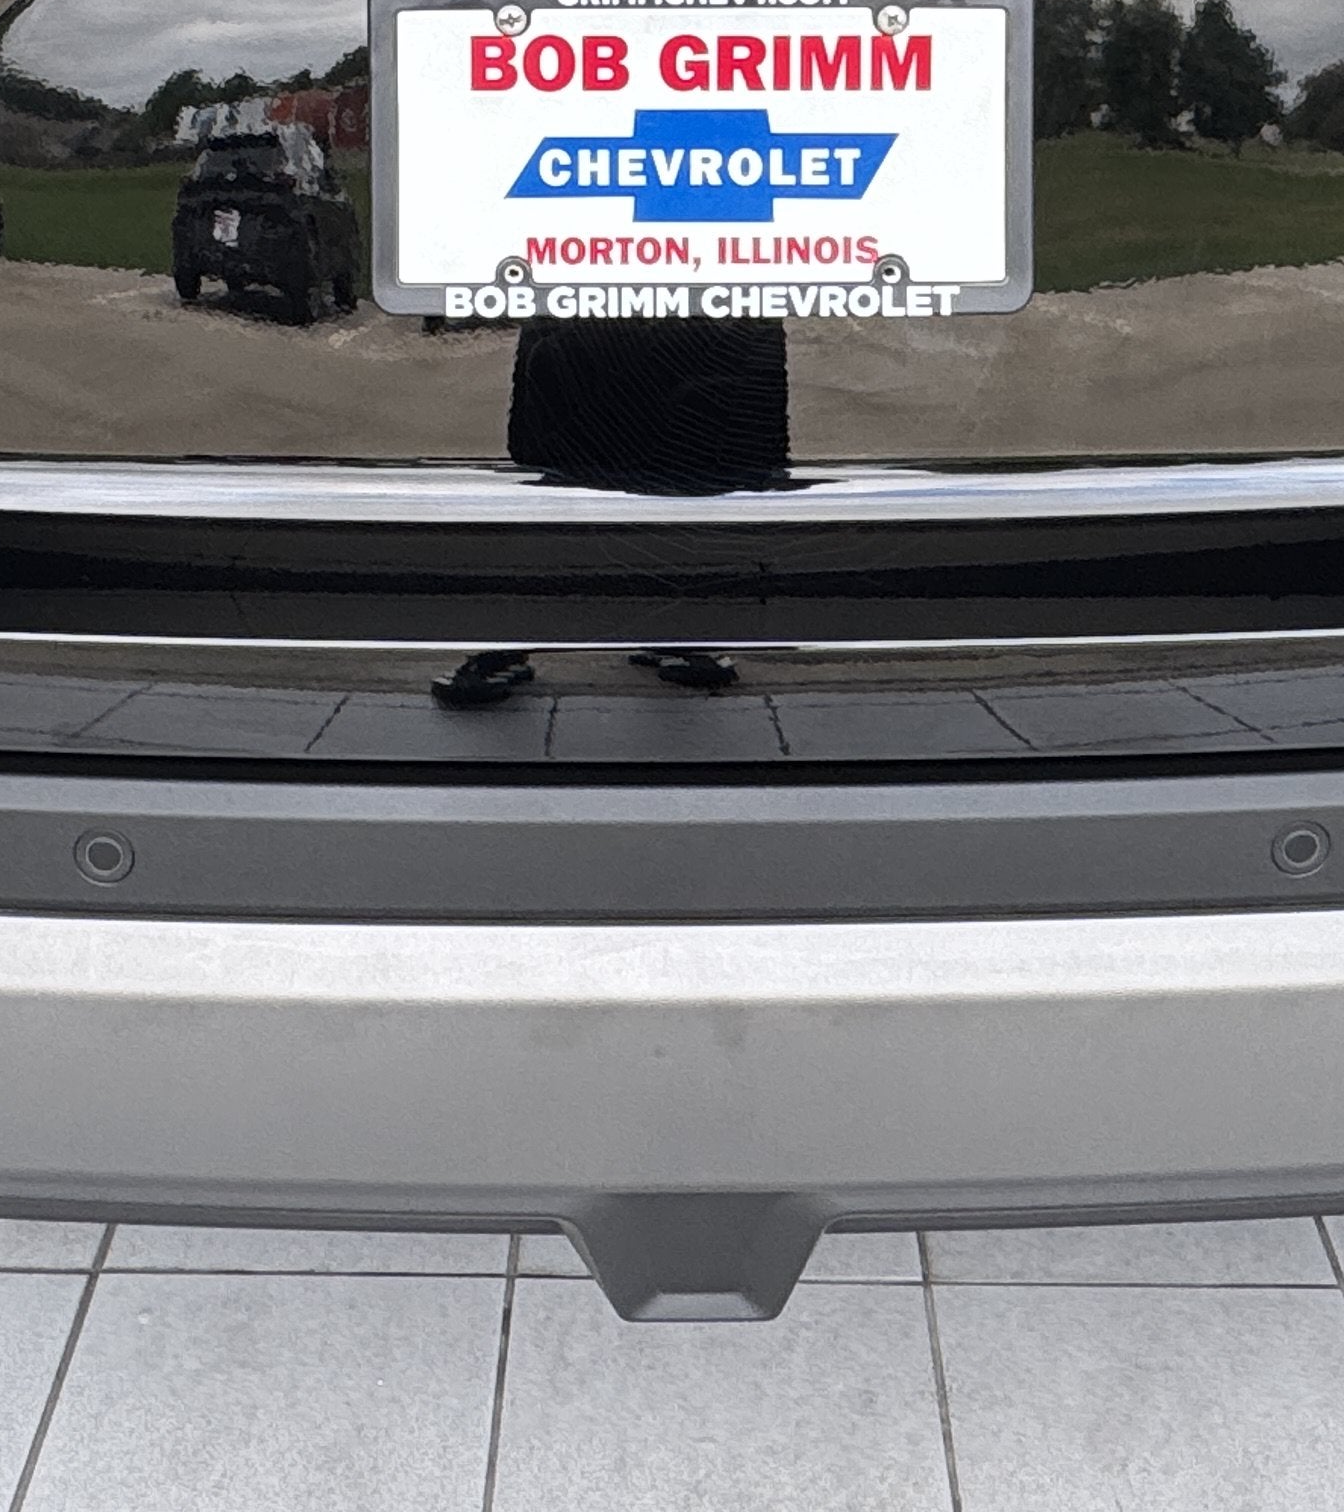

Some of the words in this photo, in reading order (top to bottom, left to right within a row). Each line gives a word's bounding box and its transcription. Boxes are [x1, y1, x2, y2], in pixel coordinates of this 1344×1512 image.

[470, 32, 631, 92] BOB
[658, 32, 933, 92] GRIMM
[538, 147, 861, 187] CHEVROLET
[526, 236, 702, 271] MORTON,
[717, 236, 879, 265] ILLINOIS
[445, 284, 537, 318] BOB
[547, 285, 689, 319] GRIMM
[701, 285, 961, 318] CHEVROLET
